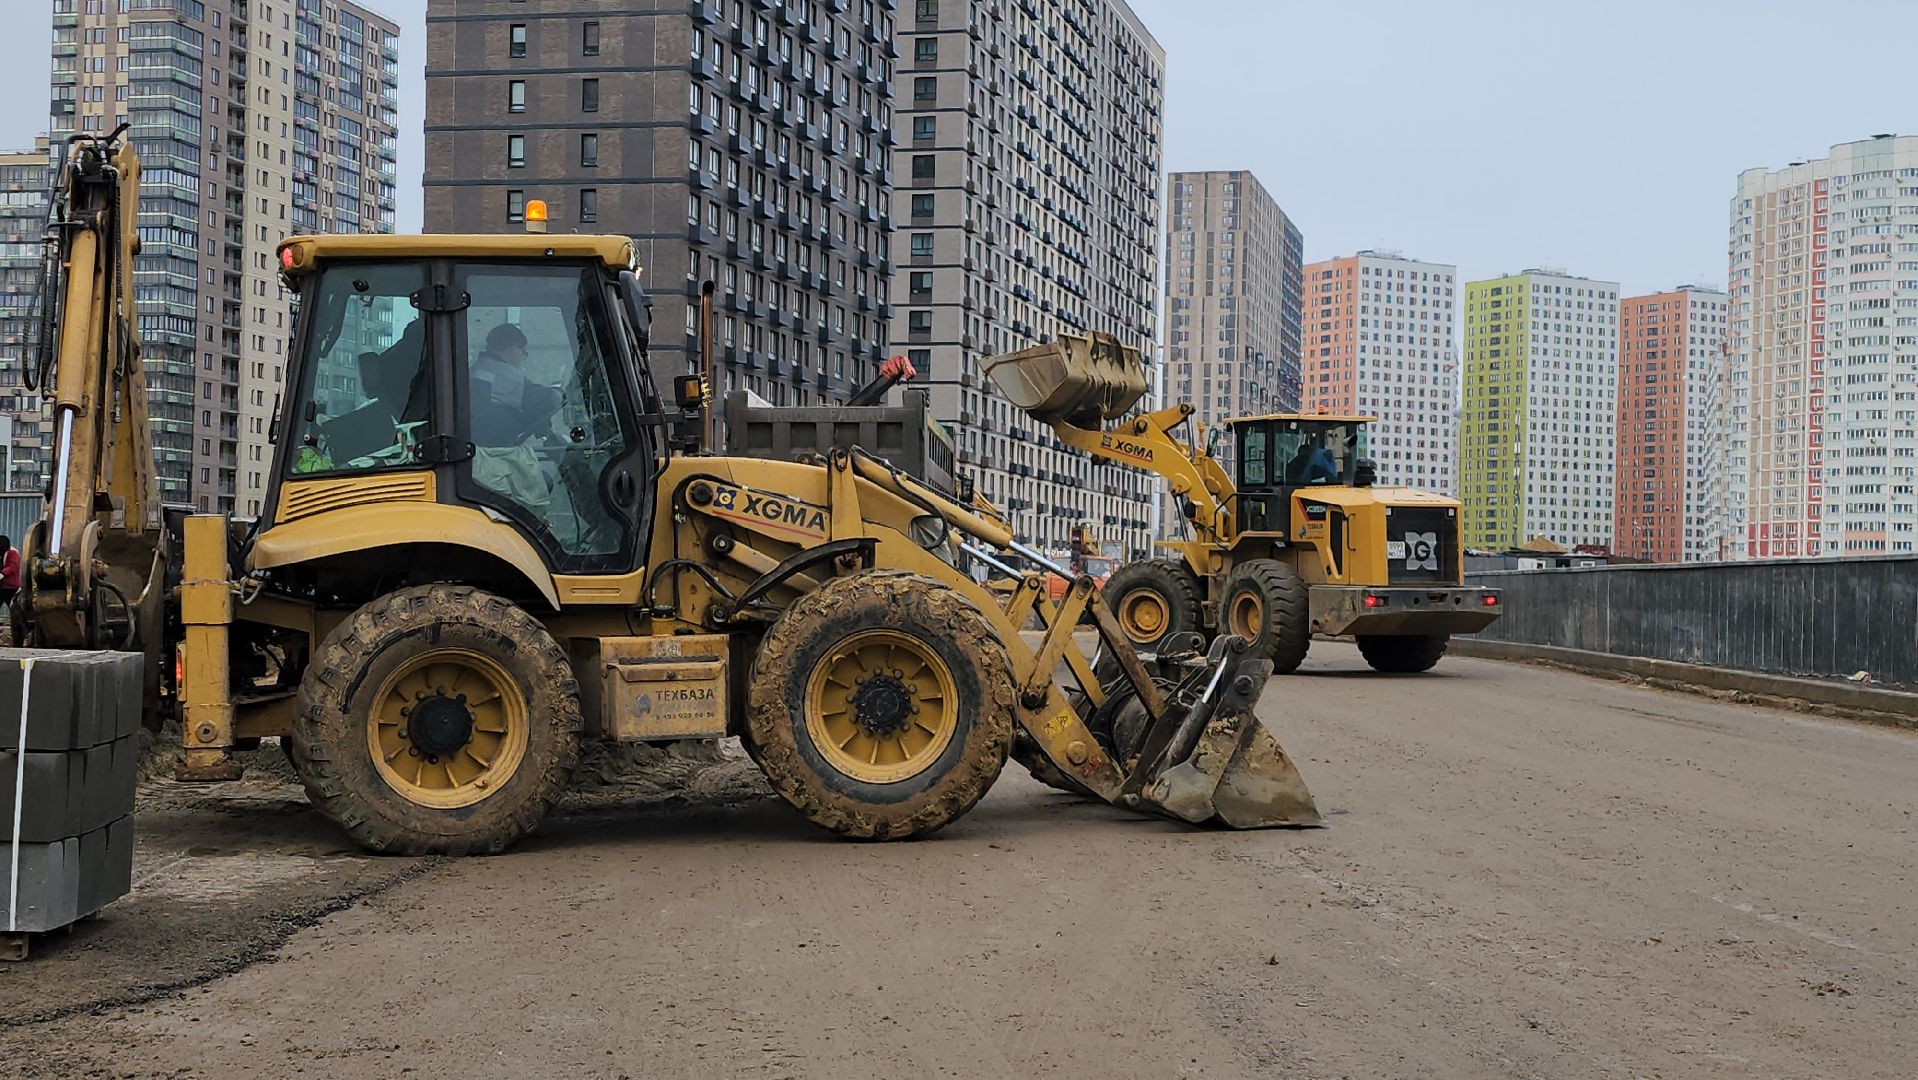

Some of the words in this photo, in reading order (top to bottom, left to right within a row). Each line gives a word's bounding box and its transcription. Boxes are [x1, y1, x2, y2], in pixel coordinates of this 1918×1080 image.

[1115, 439, 1153, 461] XGMA
[742, 493, 826, 532] XGMA
[655, 688, 714, 701] ТЕХБАЗА
